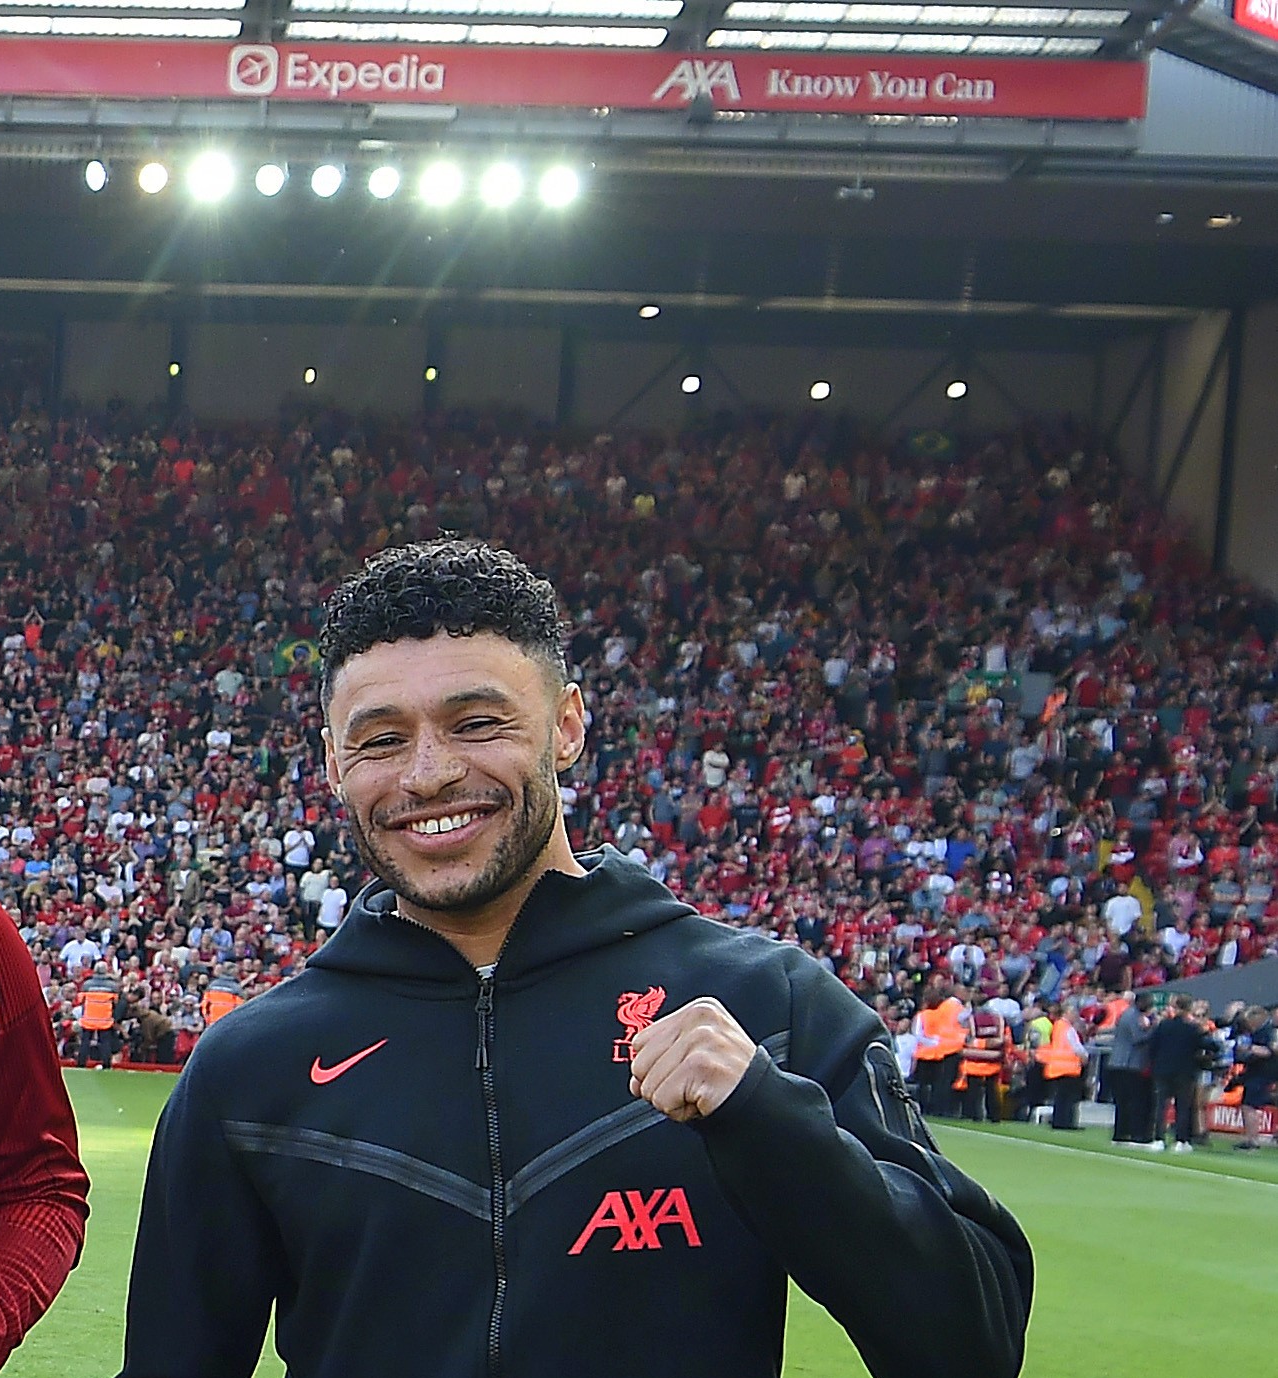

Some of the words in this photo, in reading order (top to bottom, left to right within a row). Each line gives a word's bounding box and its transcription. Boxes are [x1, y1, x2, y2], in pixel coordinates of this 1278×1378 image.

[287, 53, 445, 97] Expedia
[653, 60, 742, 101] AXA
[767, 69, 860, 98] Know
[868, 70, 928, 99] You
[933, 72, 995, 101] Can
[567, 1187, 703, 1256] AXA
